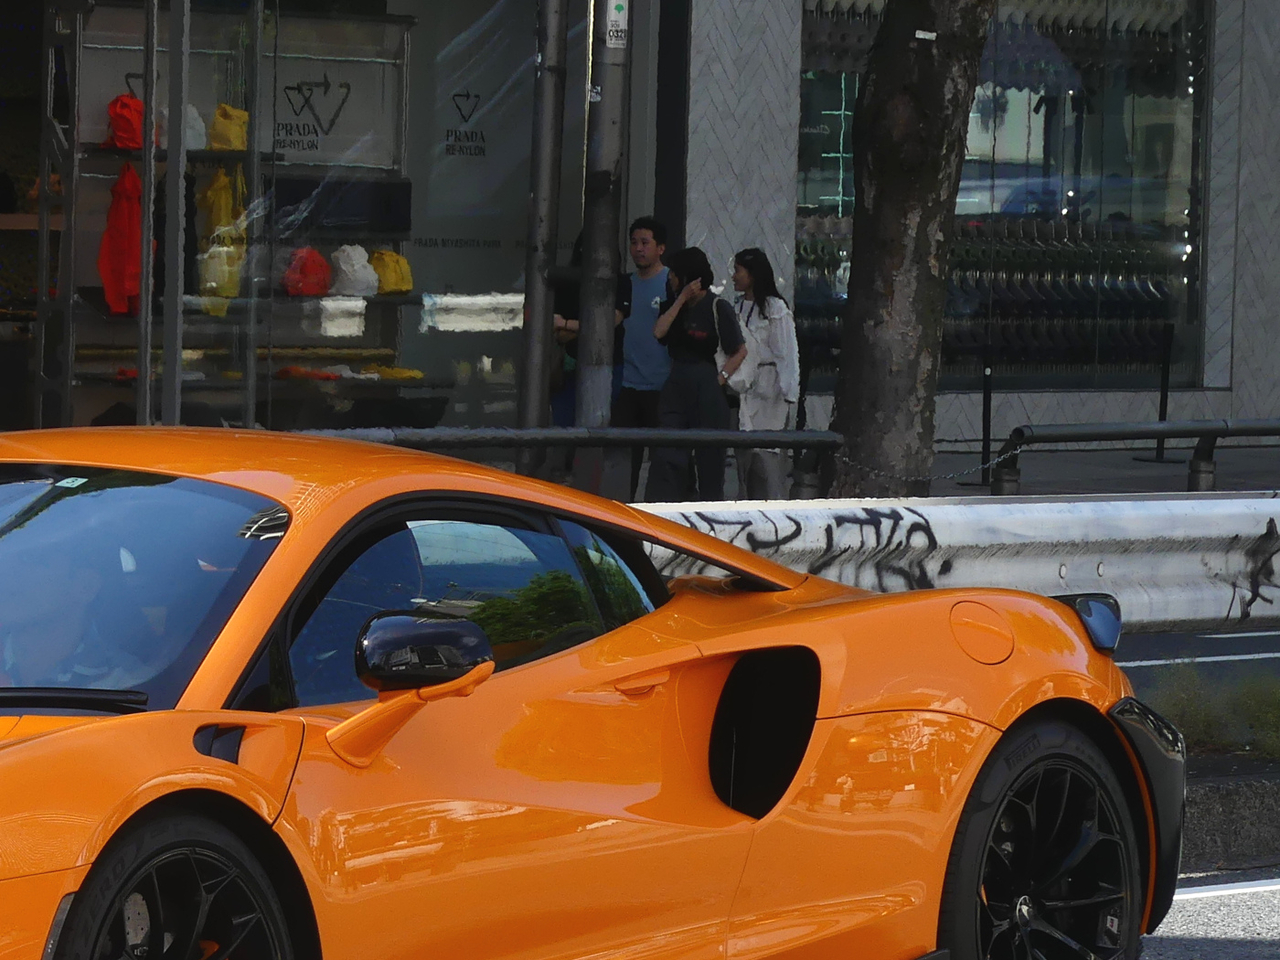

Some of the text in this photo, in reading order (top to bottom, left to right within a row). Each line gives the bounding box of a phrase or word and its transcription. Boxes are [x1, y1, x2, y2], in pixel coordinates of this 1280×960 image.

[276, 122, 319, 138] PRADA
[445, 129, 486, 143] PRADA
[445, 144, 486, 157] RE-NYLON
[1003, 733, 1040, 770] PIRELLI
